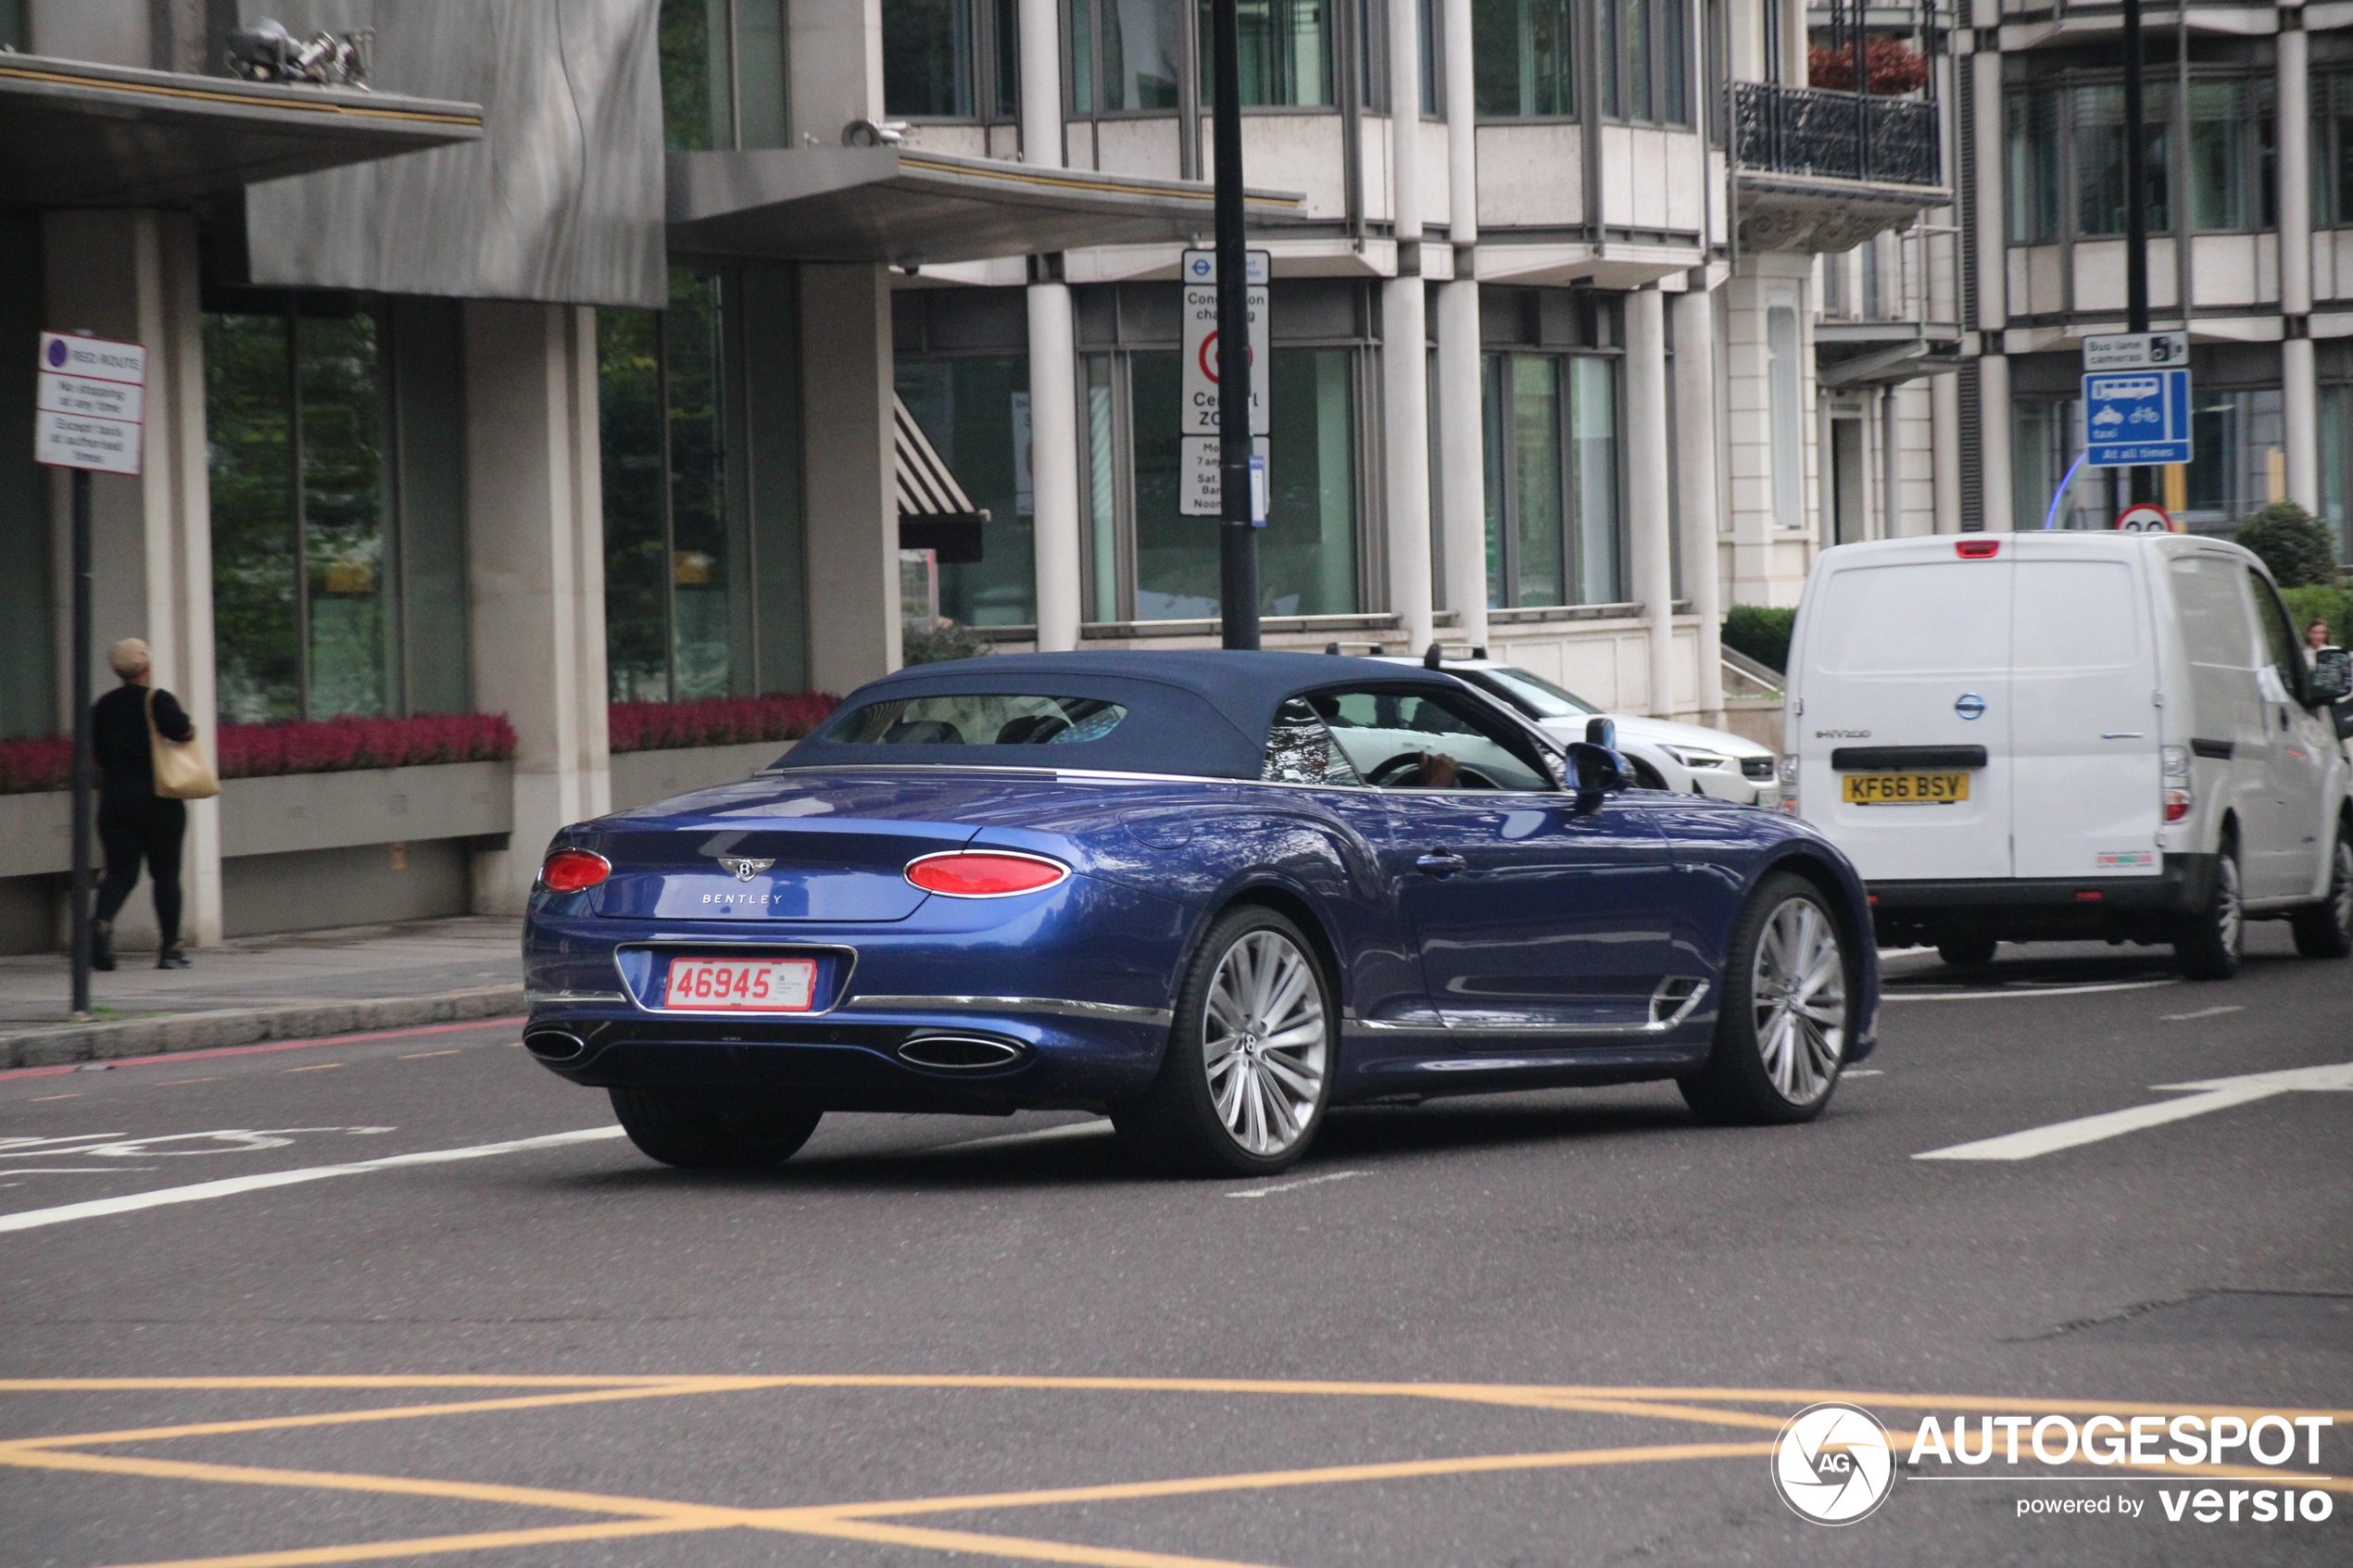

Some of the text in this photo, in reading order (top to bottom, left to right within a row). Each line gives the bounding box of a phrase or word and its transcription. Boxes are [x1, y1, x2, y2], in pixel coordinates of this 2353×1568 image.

[1188, 292, 1265, 305] Conon
[2088, 340, 2143, 352] Bus lane
[100, 353, 140, 370] ROUTE
[2089, 354, 2144, 364] cameras
[1199, 410, 1221, 425] ZO
[2092, 428, 2118, 439] taxi
[1203, 443, 1220, 452] Mo
[2102, 445, 2175, 459] At all times
[1851, 775, 1960, 798] KF66 BSV
[702, 894, 783, 905] BENTLEY
[676, 968, 772, 999] 46945
